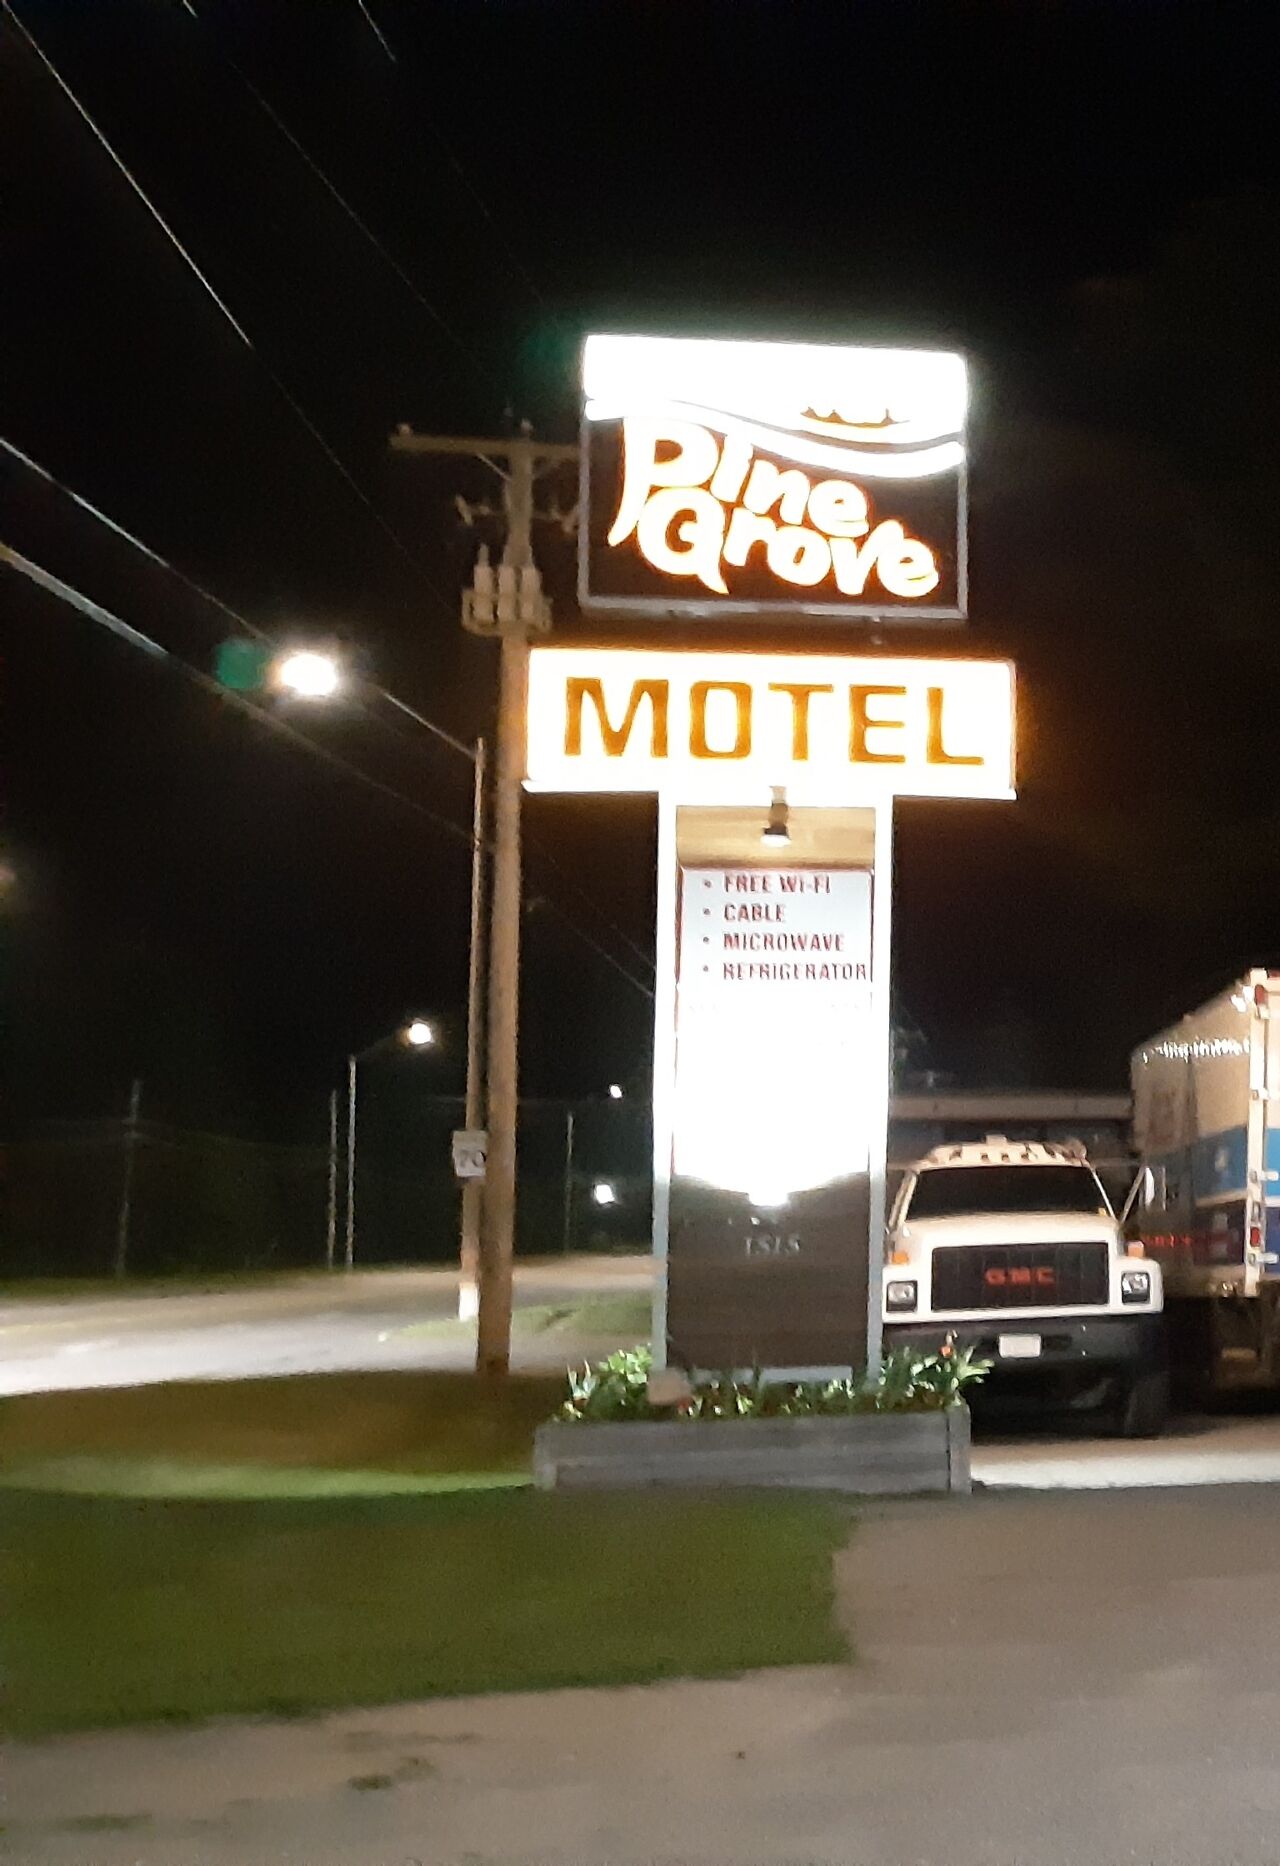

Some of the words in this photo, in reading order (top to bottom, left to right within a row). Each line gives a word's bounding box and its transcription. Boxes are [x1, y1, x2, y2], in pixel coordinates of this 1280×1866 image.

[607, 415, 869, 547] Pine
[636, 486, 940, 599] Grove
[563, 676, 986, 766] MOTEL
[724, 873, 773, 893] FREE
[778, 873, 831, 894] WI-FI
[723, 903, 787, 923] CABLE
[722, 932, 846, 952] MICROWAVE
[722, 961, 868, 981] REFRIGERATOR
[984, 1266, 1055, 1286] GMC
